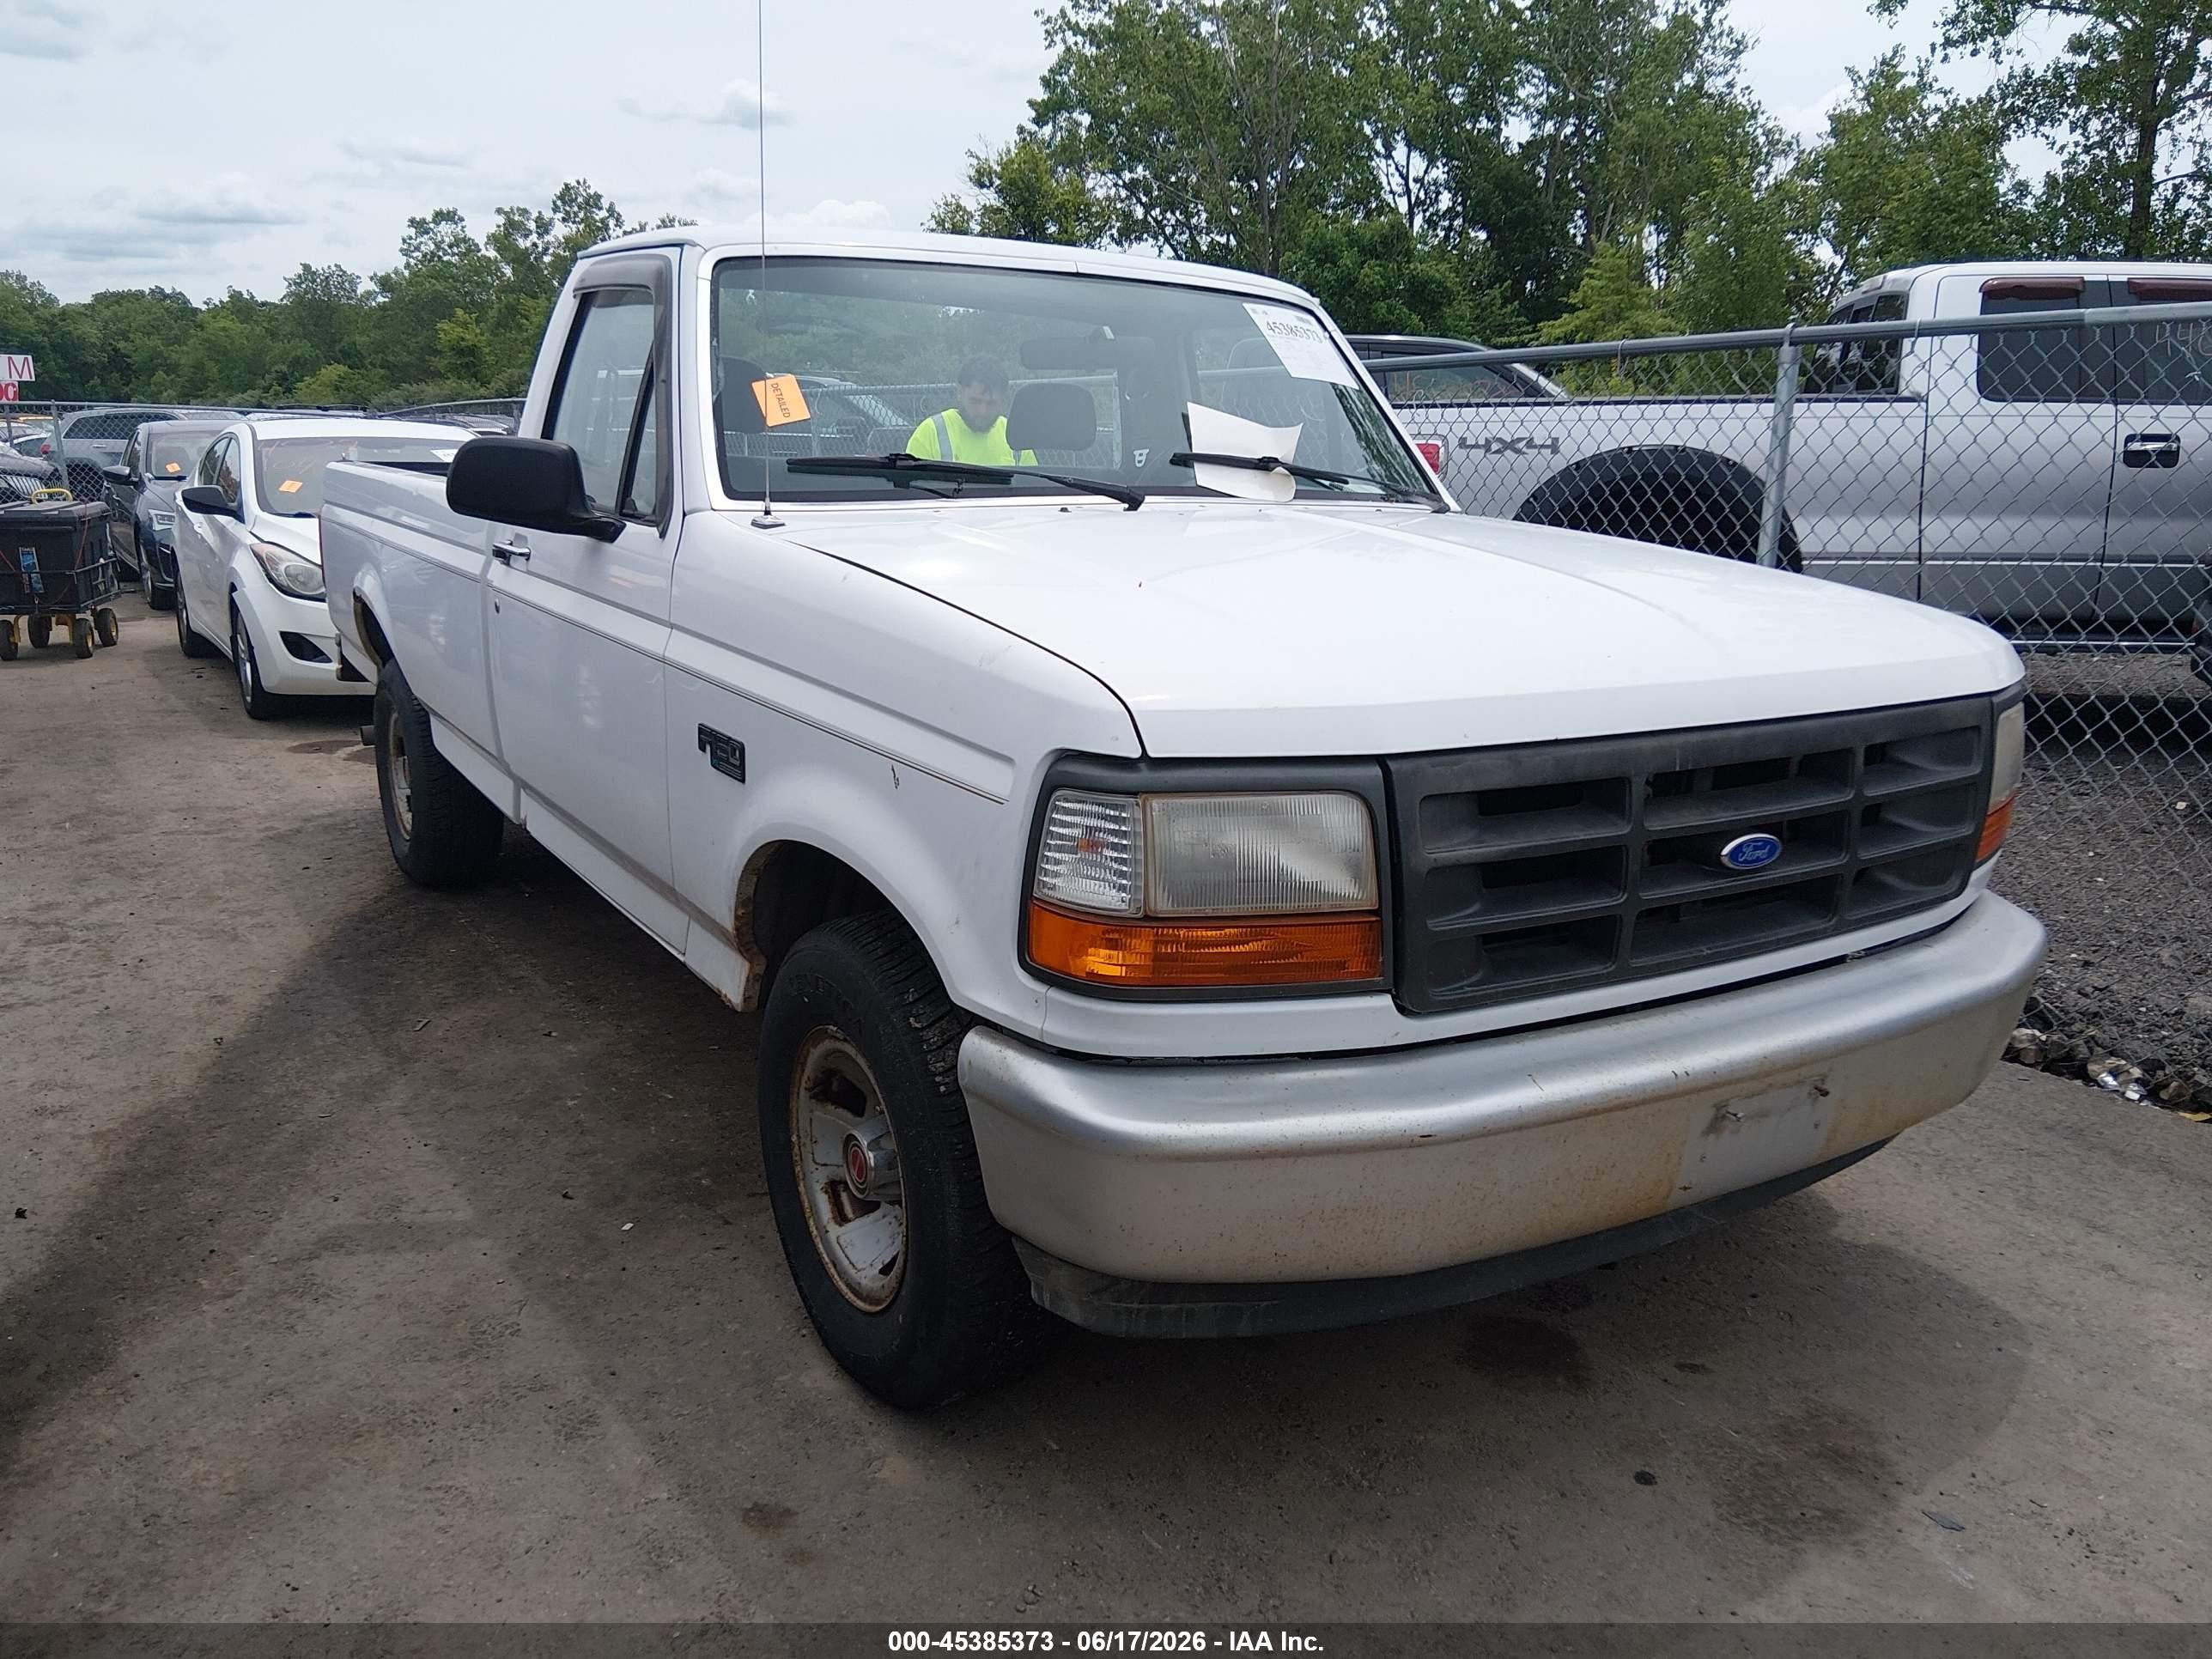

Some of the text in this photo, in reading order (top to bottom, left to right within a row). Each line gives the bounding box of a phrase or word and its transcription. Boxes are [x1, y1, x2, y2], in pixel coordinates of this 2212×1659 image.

[1266, 320, 1323, 343] 45385373
[770, 382, 791, 418] DETAILED
[1737, 842, 1771, 862] Ford
